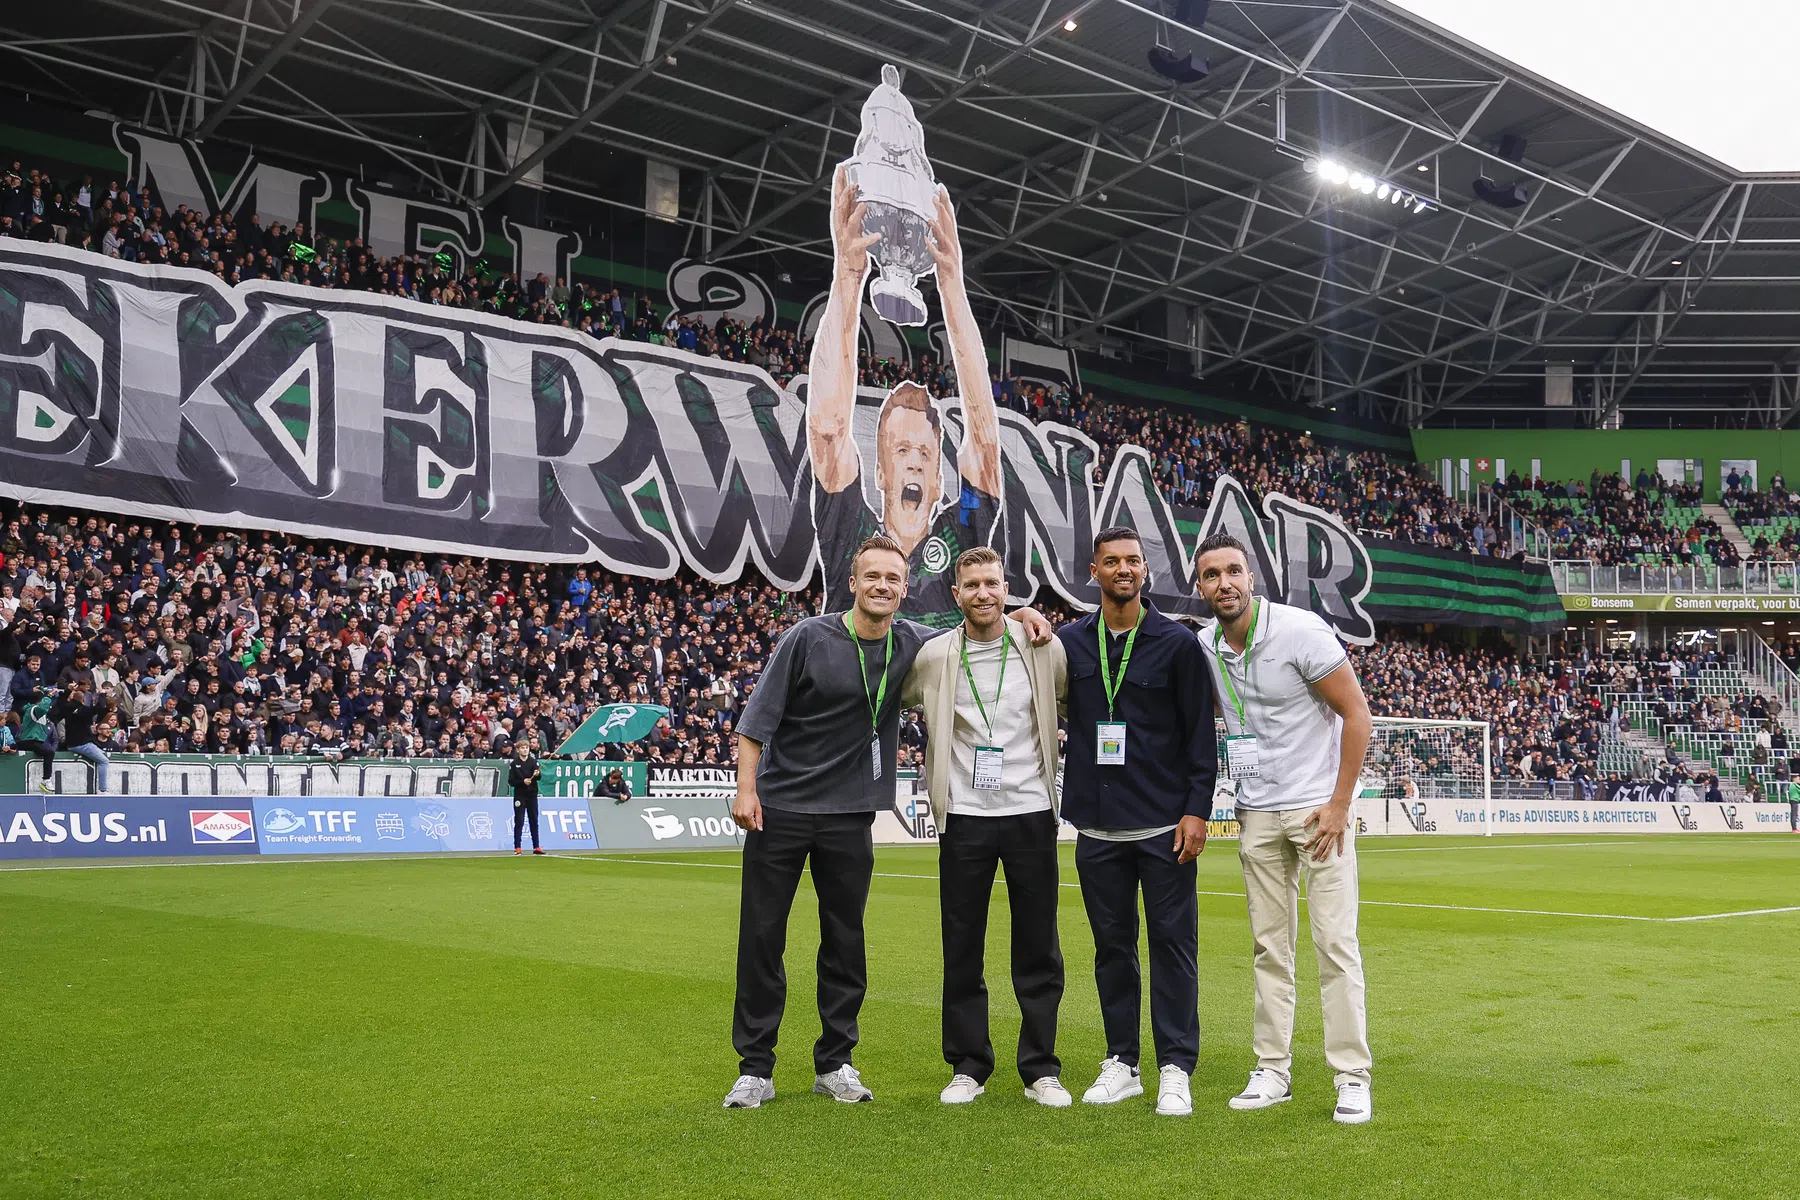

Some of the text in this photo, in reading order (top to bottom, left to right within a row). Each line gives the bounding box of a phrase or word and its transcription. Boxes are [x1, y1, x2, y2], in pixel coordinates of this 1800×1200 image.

[1591, 597, 1634, 608] Bonsema
[1674, 598, 1712, 609] Samen
[1714, 598, 1760, 611] verpakt,
[1762, 600, 1787, 609] voor
[652, 768, 737, 782] MARTINI
[307, 810, 357, 833] TFF
[541, 810, 588, 833] TFF
[1455, 809, 1657, 823] Van dr Plas ADVISEURS & ARCHITECTEN
[1755, 811, 1770, 823] Van
[1771, 811, 1783, 823] der
[0, 812, 167, 843] ASUS.nl
[203, 823, 242, 831] AMASUS
[688, 816, 745, 837] noo
[265, 835, 362, 844] Team Freight Forwarding
